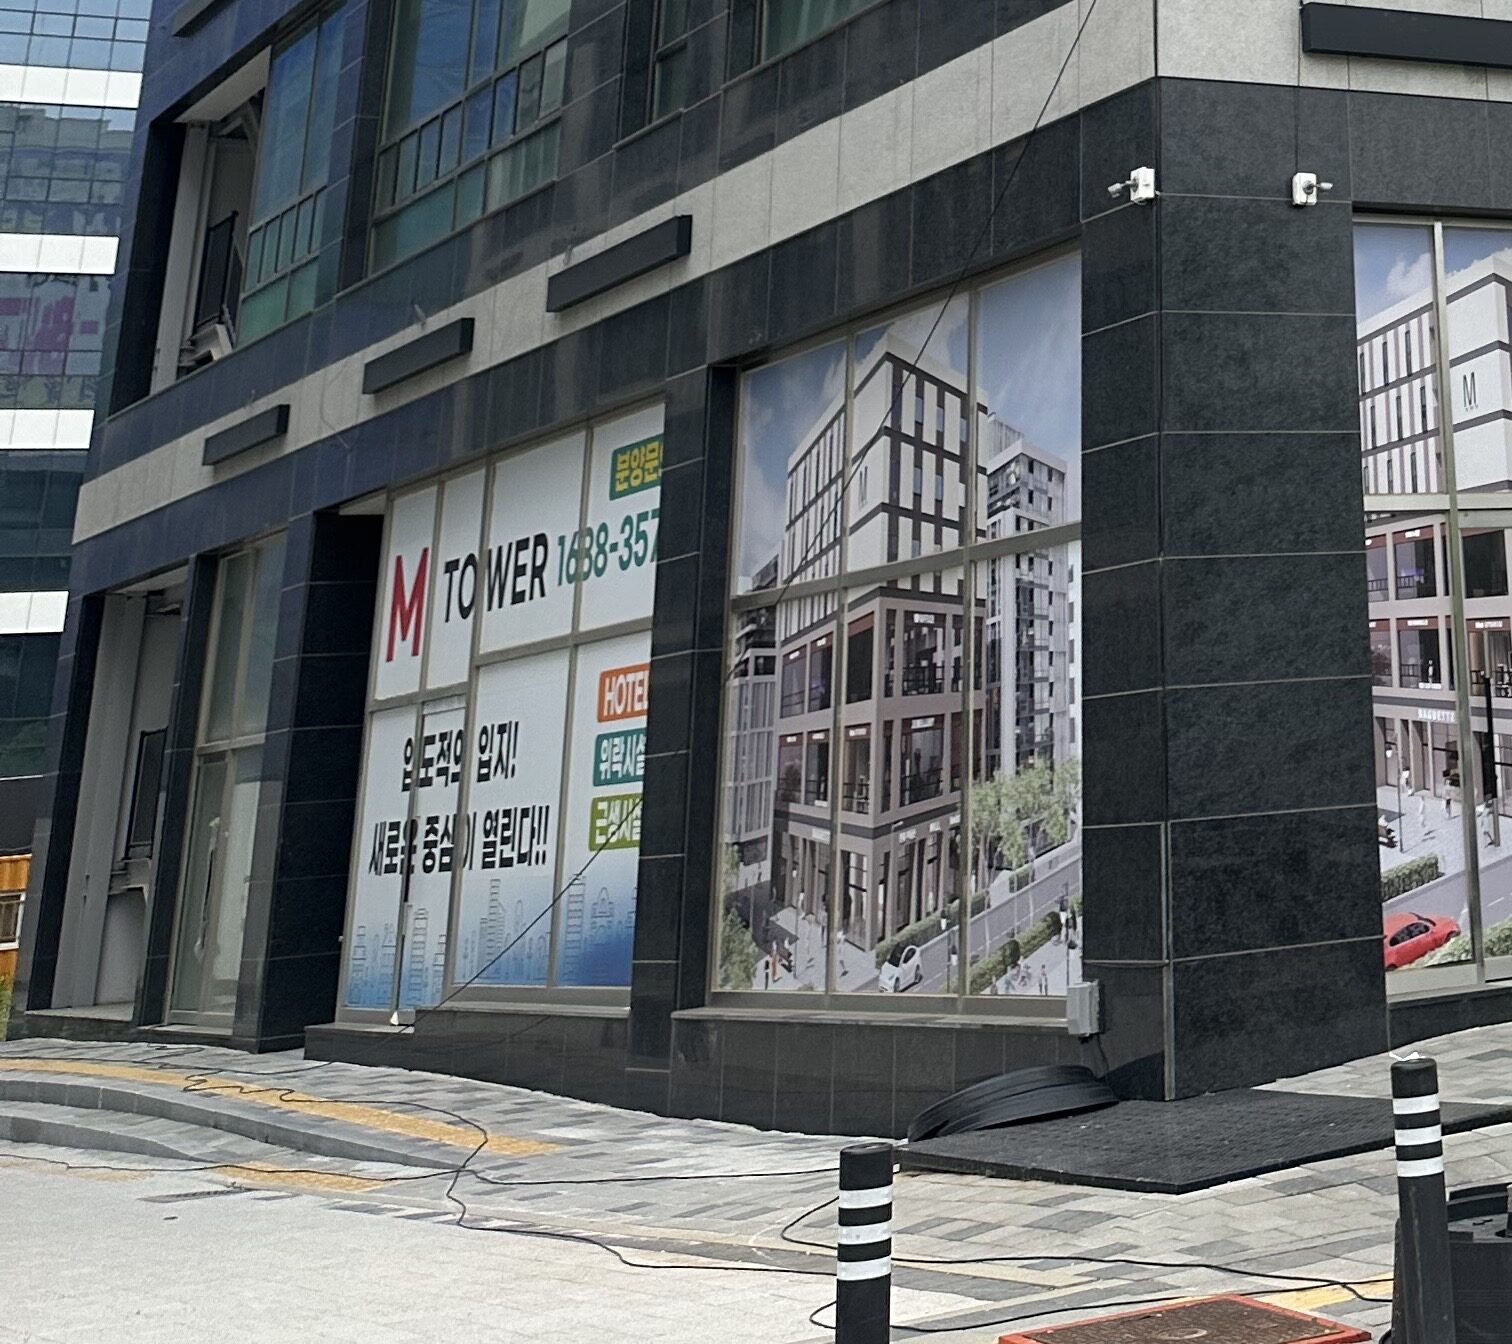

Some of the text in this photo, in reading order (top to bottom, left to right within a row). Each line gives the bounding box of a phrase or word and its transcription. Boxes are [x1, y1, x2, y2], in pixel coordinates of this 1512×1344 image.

[615, 441, 664, 493] 분양문
[386, 546, 430, 663] M
[444, 532, 549, 624] TOWER
[603, 669, 650, 717] HOTEL
[476, 720, 520, 784] 입지!
[481, 804, 551, 870] 열린다!!
